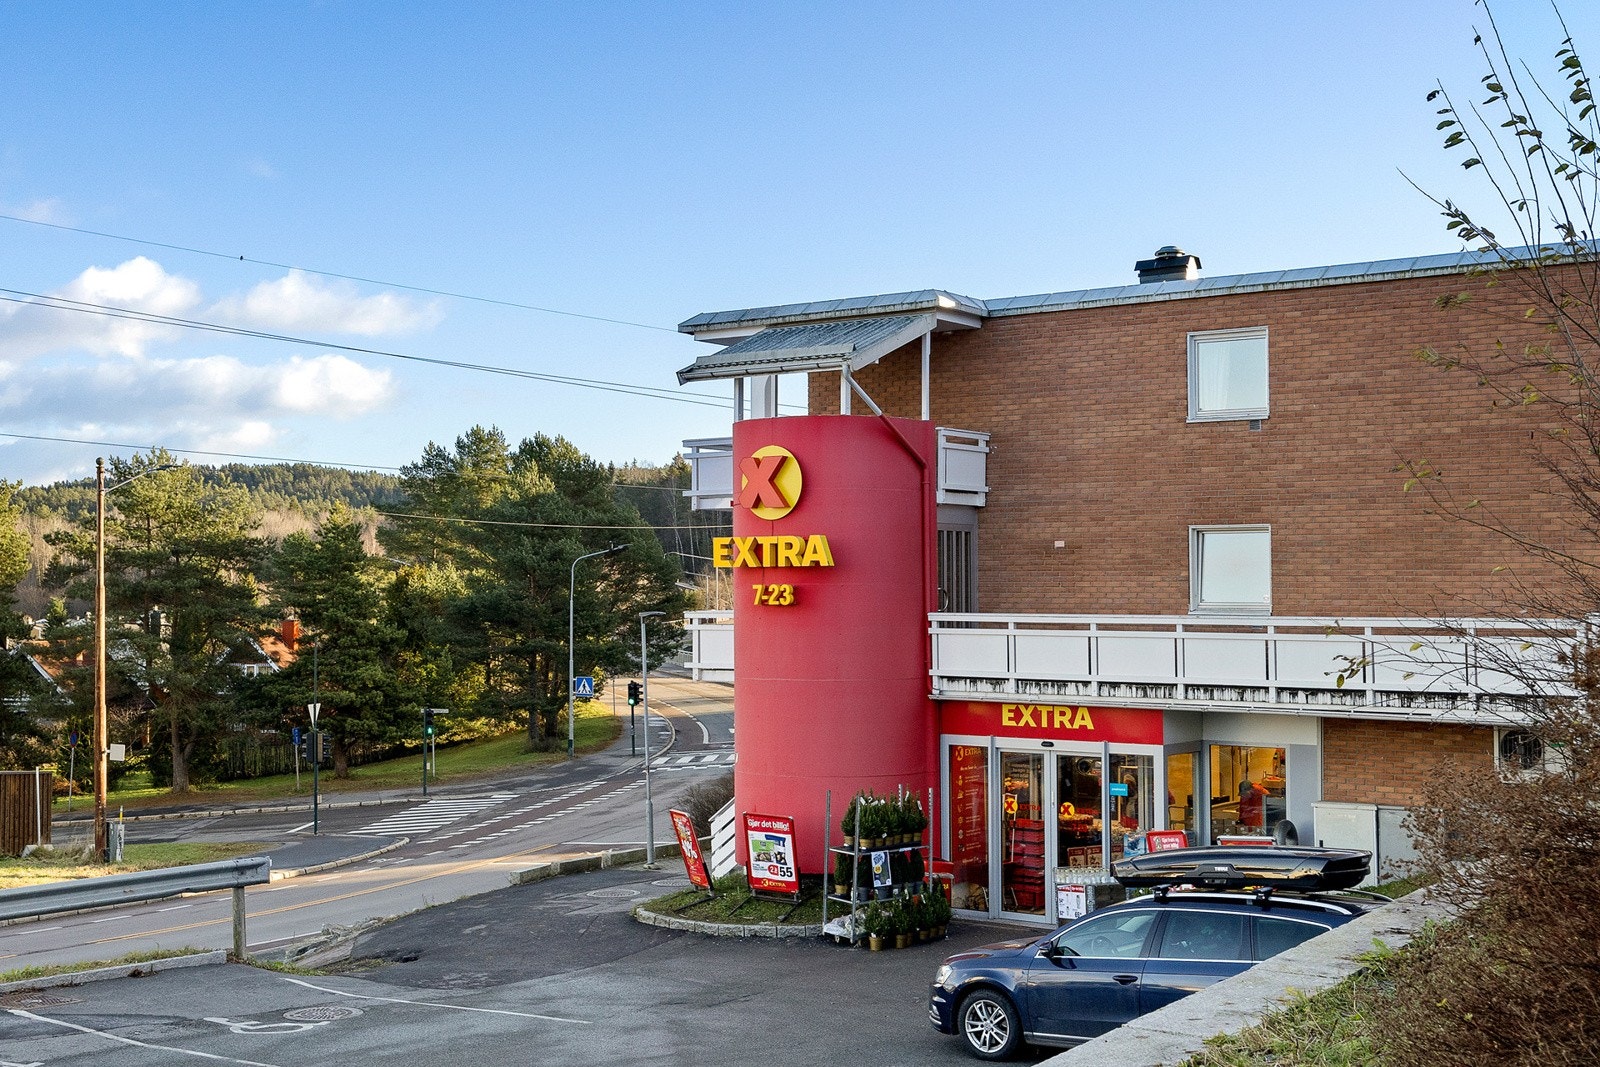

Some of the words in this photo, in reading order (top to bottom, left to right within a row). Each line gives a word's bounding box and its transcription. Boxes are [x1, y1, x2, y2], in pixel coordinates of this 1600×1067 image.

[738, 455, 791, 509] X
[712, 534, 835, 568] EXTRA
[752, 583, 794, 606] 7-23
[1001, 703, 1095, 730] EXTRA
[964, 747, 982, 756] EXTRA
[1004, 800, 1015, 812] X
[1019, 803, 1041, 811] EXTRA
[1061, 804, 1072, 816] X
[747, 818, 760, 828] Gjør
[761, 820, 772, 828] det
[780, 866, 793, 878] 55
